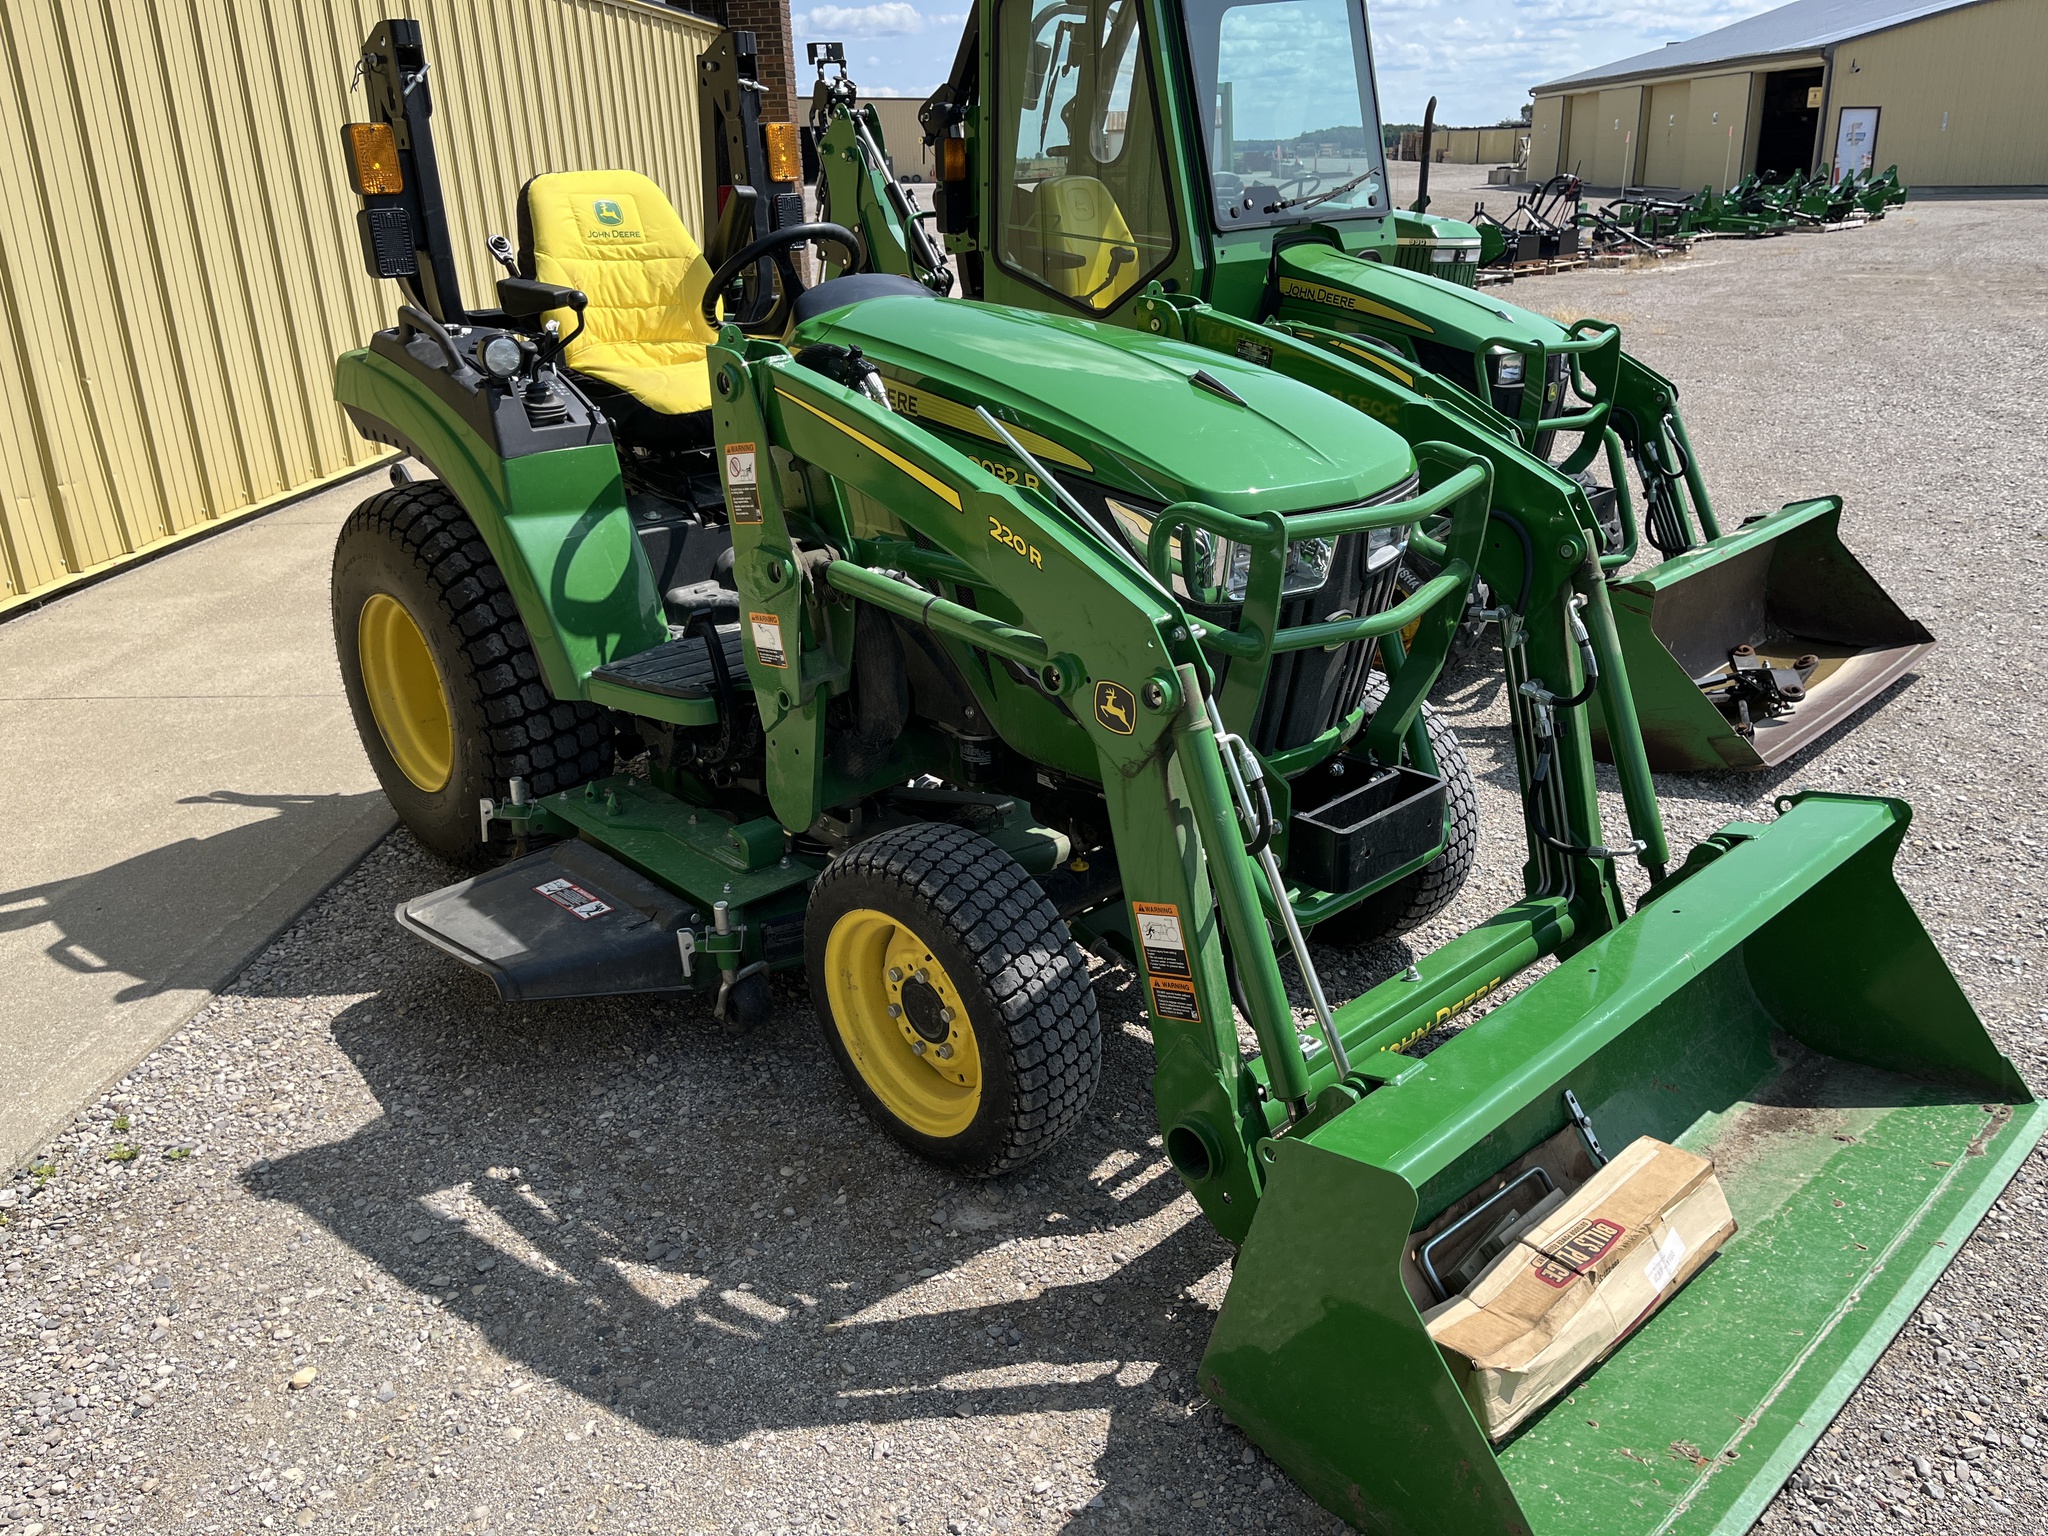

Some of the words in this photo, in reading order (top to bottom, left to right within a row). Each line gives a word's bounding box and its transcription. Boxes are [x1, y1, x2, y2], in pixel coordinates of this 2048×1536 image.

[587, 230, 611, 238] JOHN
[611, 230, 640, 238] DEERE
[1284, 282, 1316, 300] JOHN
[1316, 288, 1356, 309] DEERE
[887, 387, 918, 415] ERE
[731, 444, 754, 452] WARNING
[1024, 471, 1041, 491] R
[989, 515, 1027, 556] 220
[1029, 544, 1043, 571] R
[1144, 906, 1173, 915] WARNING
[1161, 981, 1190, 991] WARNING
[1381, 1021, 1431, 1053] OHN
[1573, 1222, 1619, 1253] BILL'S
